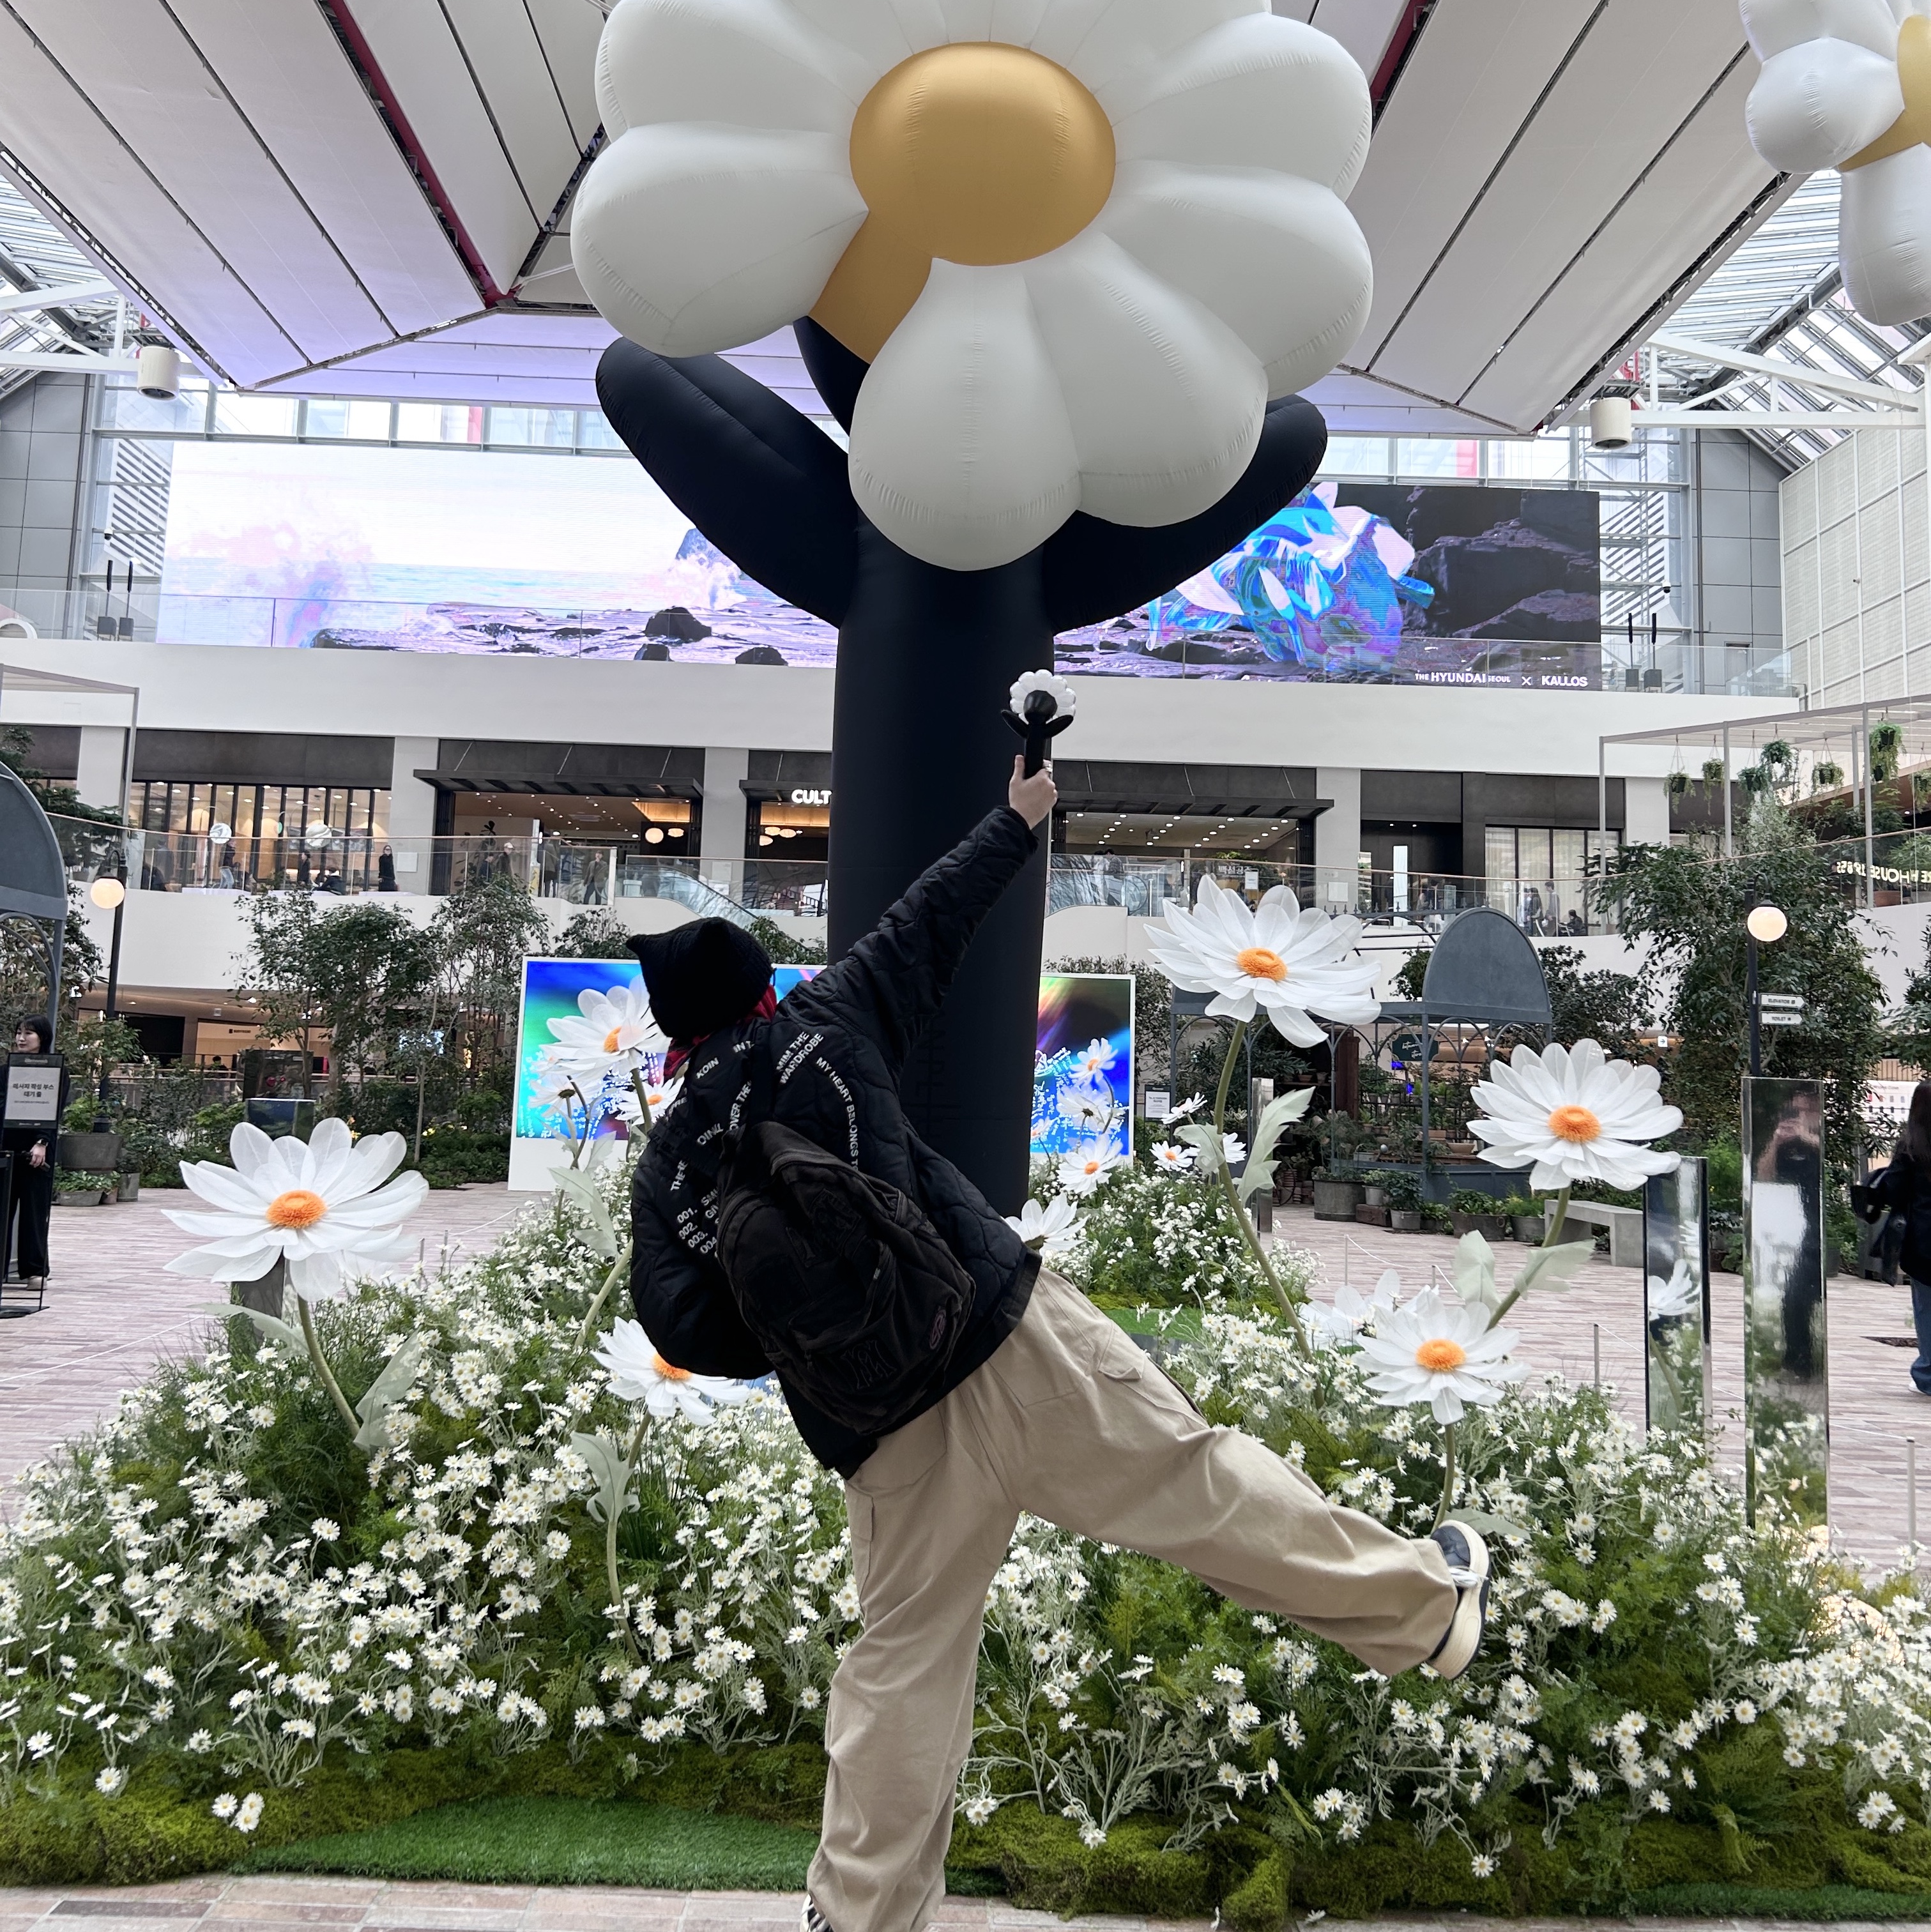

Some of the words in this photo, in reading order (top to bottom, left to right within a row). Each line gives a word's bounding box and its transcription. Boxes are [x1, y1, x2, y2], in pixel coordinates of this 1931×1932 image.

[1431, 672, 1486, 683] HYUNDAI
[1541, 675, 1589, 687] KALLOS
[791, 789, 832, 804] CULT
[789, 1031, 810, 1050] THE
[780, 1033, 824, 1084] WARDROBE
[816, 1056, 832, 1072] MY
[829, 1070, 853, 1102] HEART
[846, 1104, 859, 1157] BELONGS
